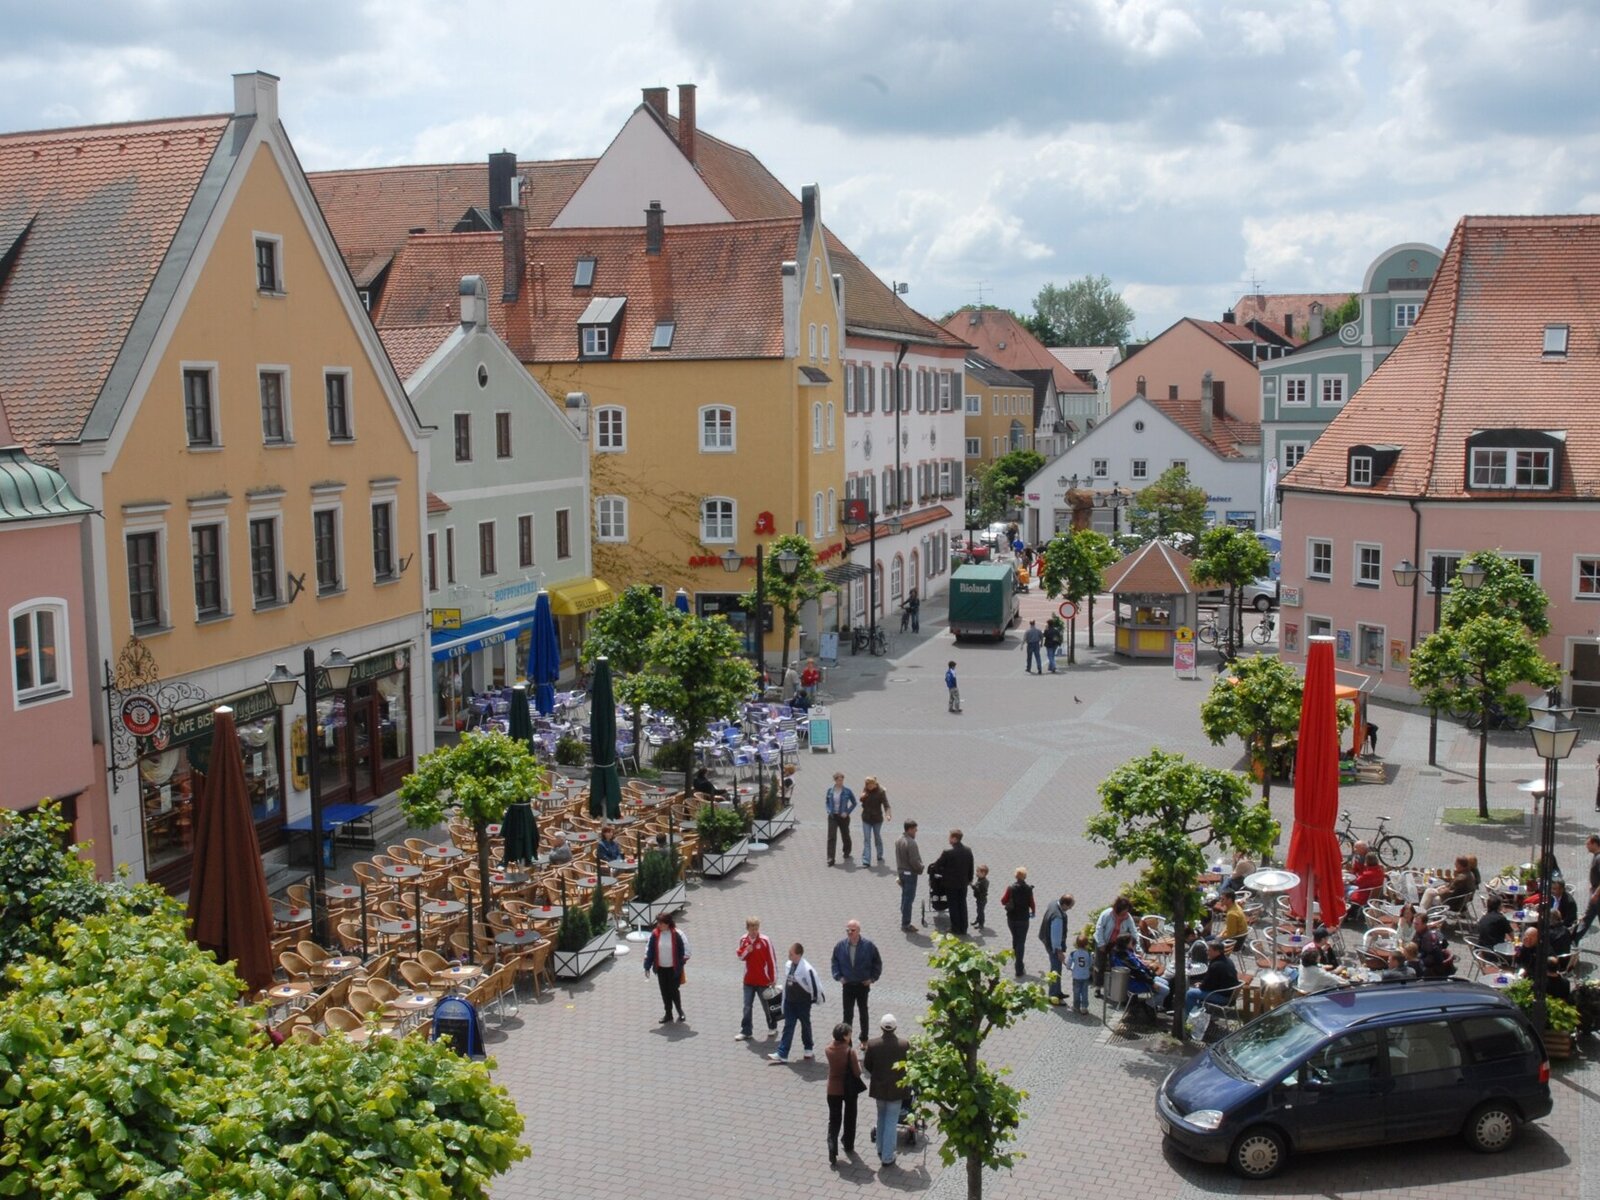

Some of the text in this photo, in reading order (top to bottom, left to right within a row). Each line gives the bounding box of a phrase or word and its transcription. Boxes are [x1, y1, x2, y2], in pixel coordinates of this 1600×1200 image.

[959, 582, 991, 593] Bioland
[125, 700, 155, 714] ERDINGER
[1078, 956, 1086, 968] 5
